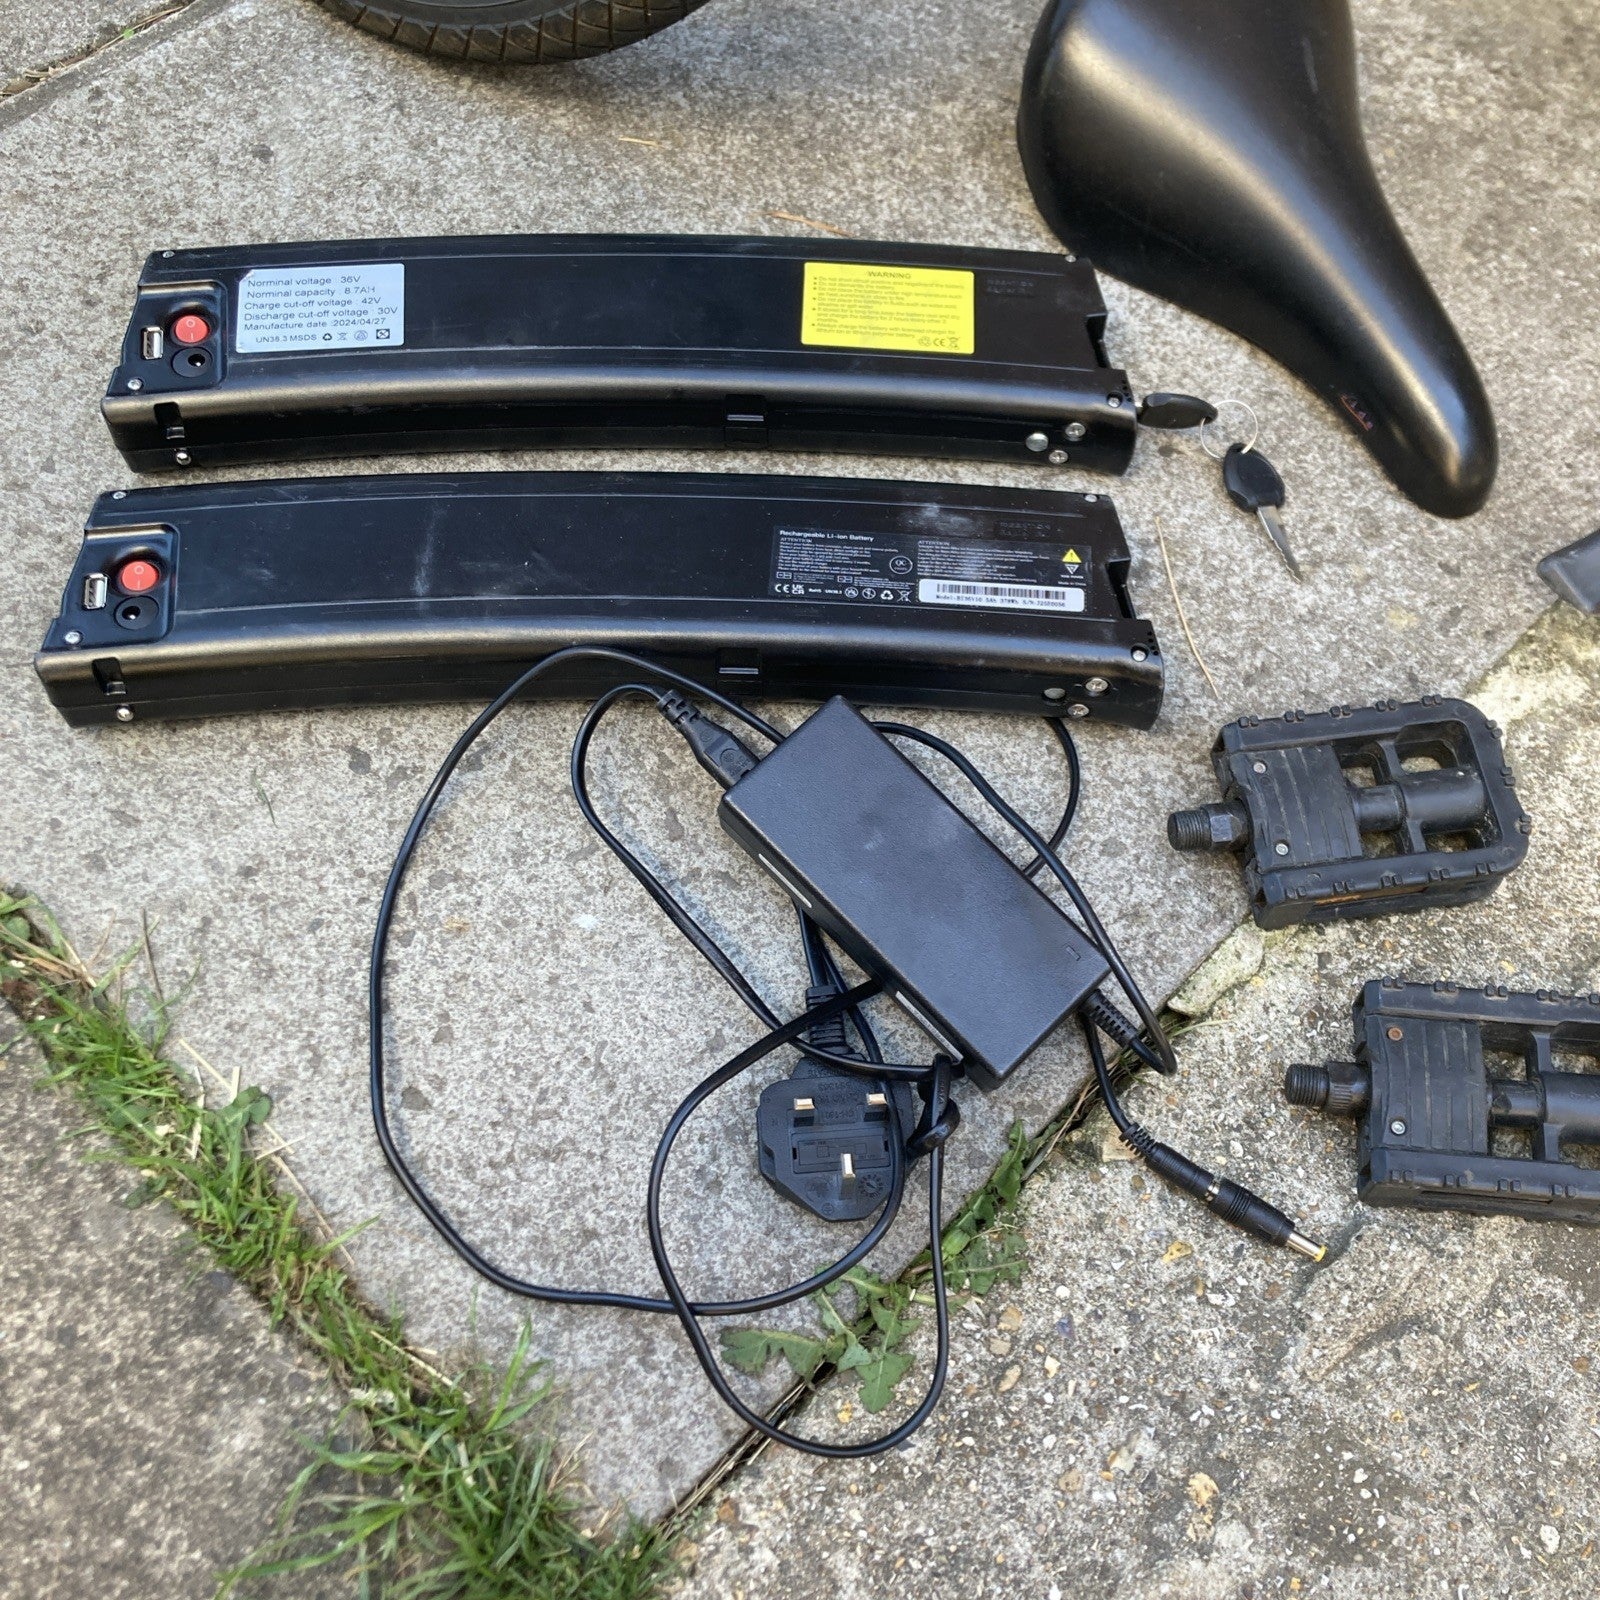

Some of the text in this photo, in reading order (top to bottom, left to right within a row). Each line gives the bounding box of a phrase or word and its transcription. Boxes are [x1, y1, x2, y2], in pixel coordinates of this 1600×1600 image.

[868, 271, 911, 279] WARNING
[248, 276, 361, 287] Norminal voltage 36V
[247, 290, 292, 298] Norminal
[295, 288, 336, 298] capacity
[244, 302, 280, 310] Charge
[317, 298, 352, 307] voltage
[244, 312, 295, 321] Discharge
[298, 310, 329, 318] cut-off
[332, 308, 368, 317] voltage
[244, 322, 304, 331] Manufacture
[780, 530, 825, 538] Rechargeable
[774, 584, 789, 593] CE
